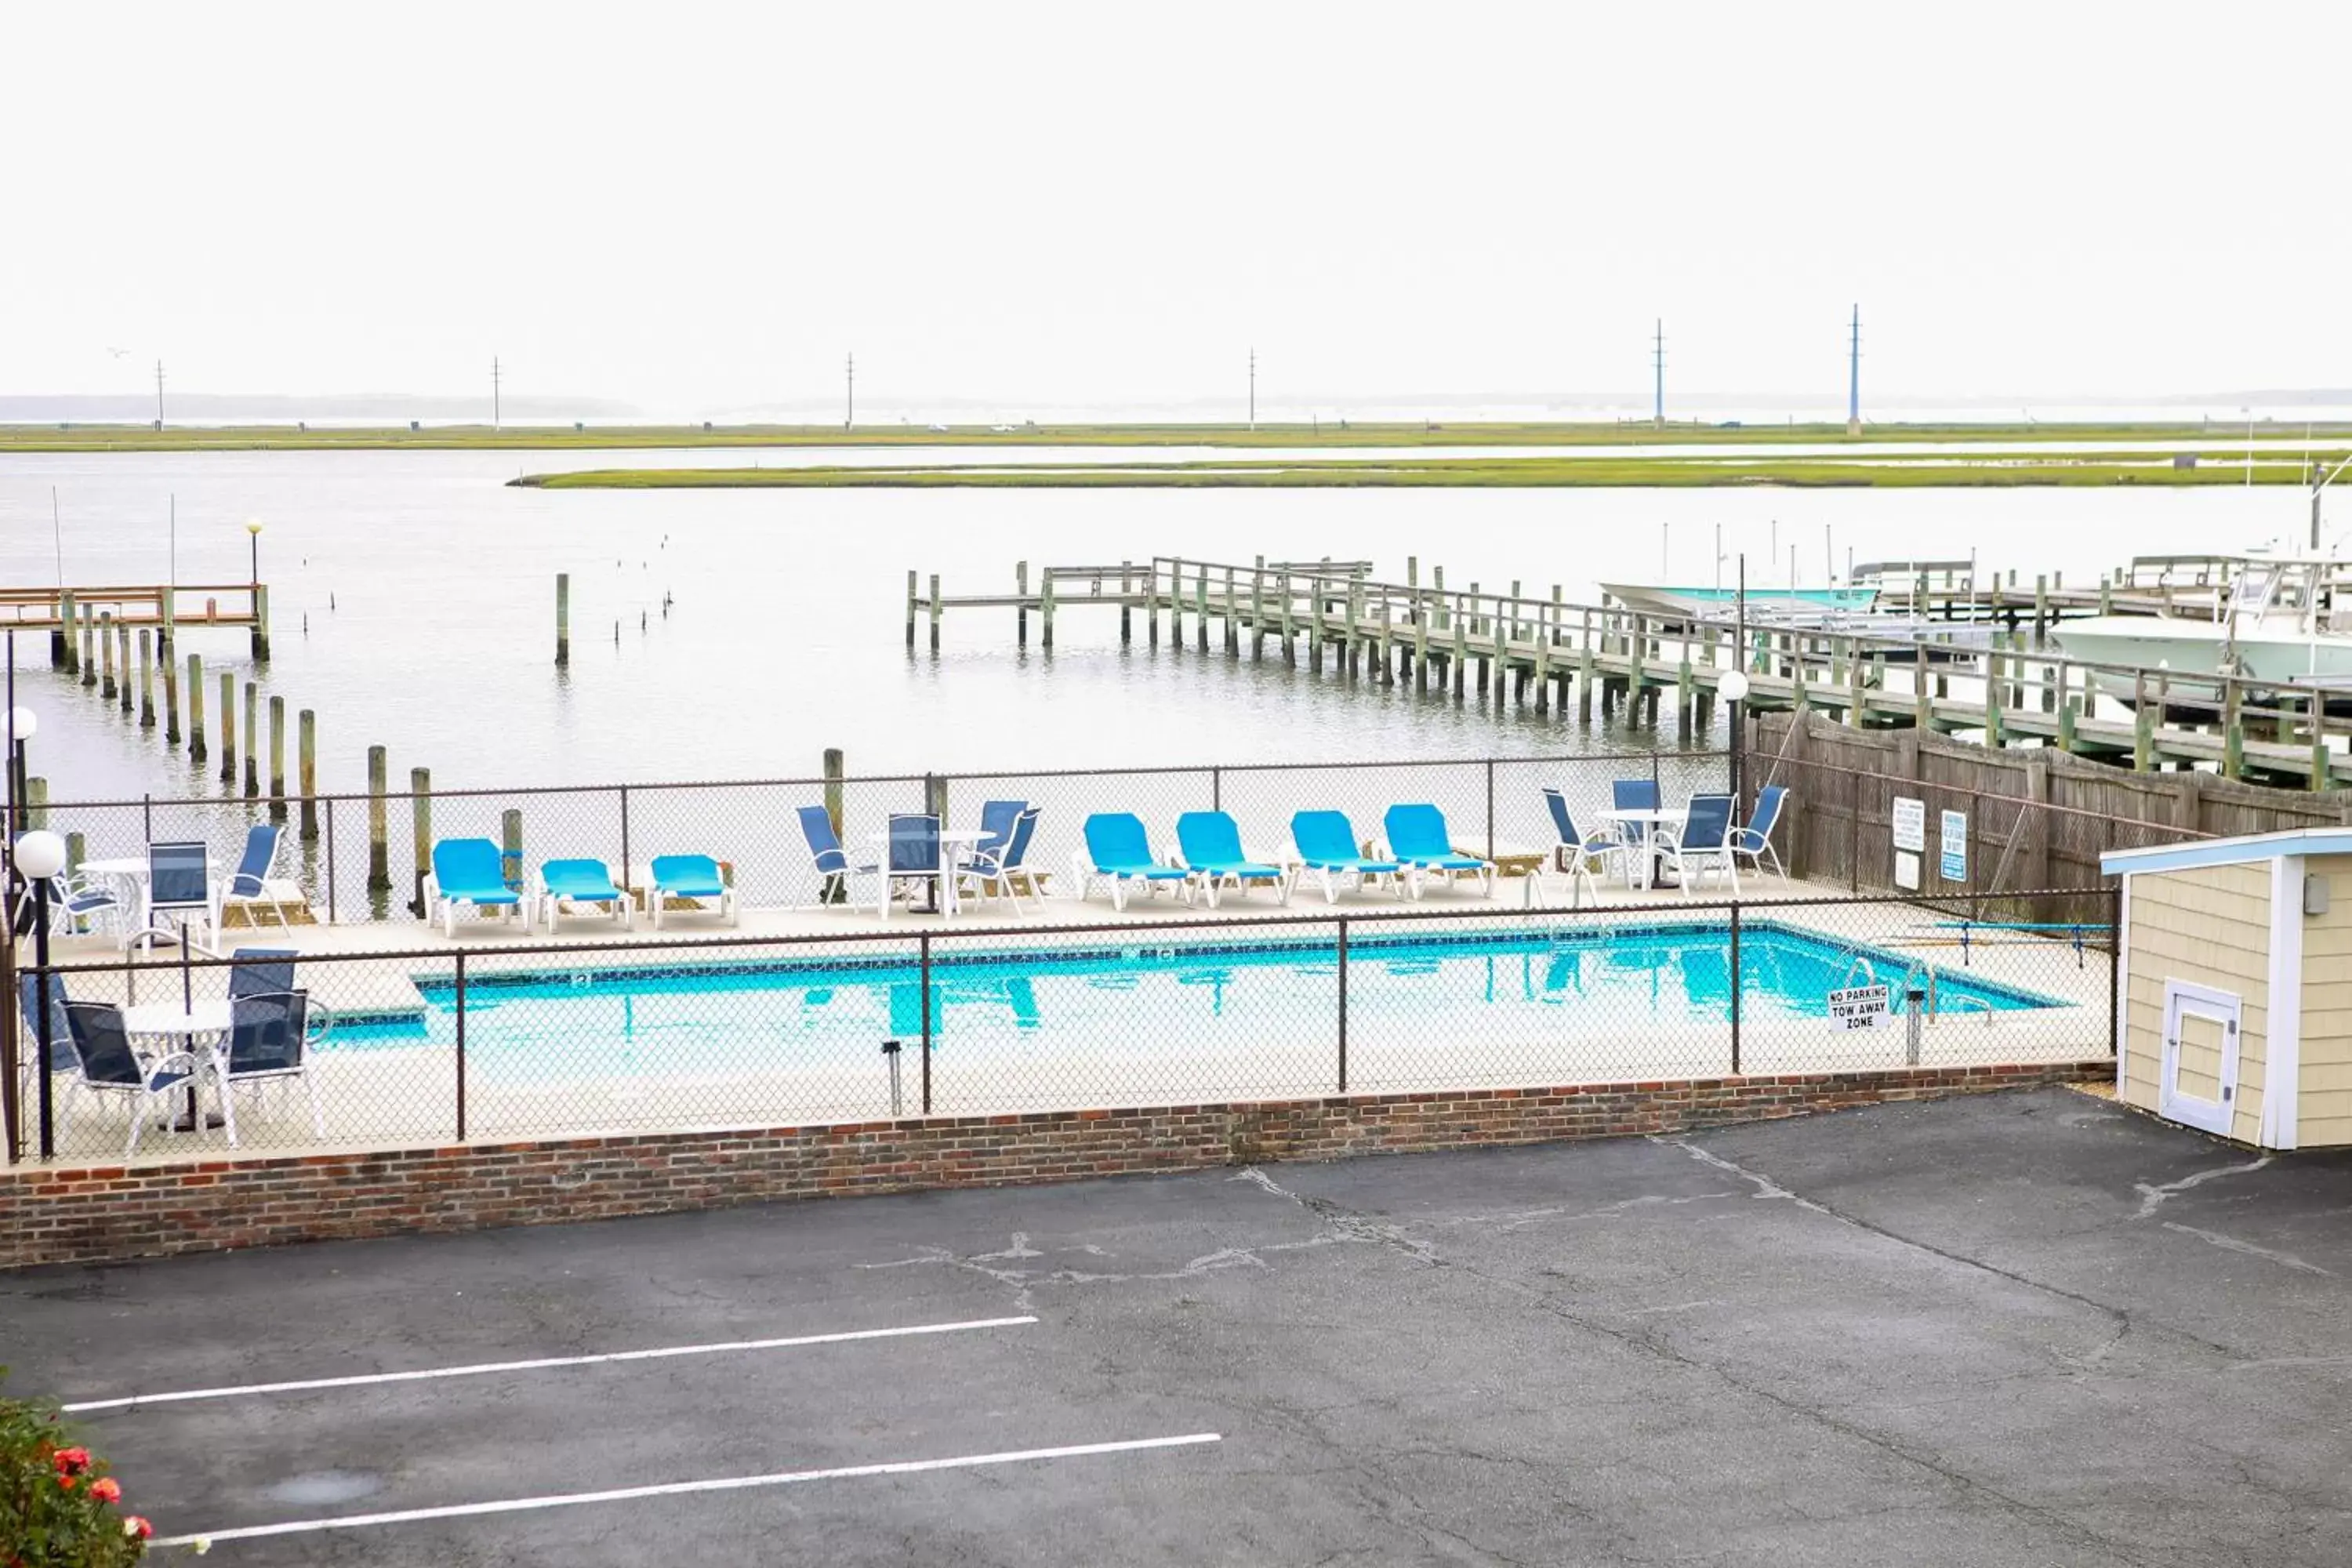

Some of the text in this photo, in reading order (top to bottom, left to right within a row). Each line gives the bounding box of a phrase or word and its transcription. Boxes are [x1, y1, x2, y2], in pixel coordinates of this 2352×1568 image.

[1831, 987, 1886, 1002] NO PARKING
[1833, 1002, 1886, 1018] TOW AWAY
[1847, 1016, 1873, 1029] ZONE
